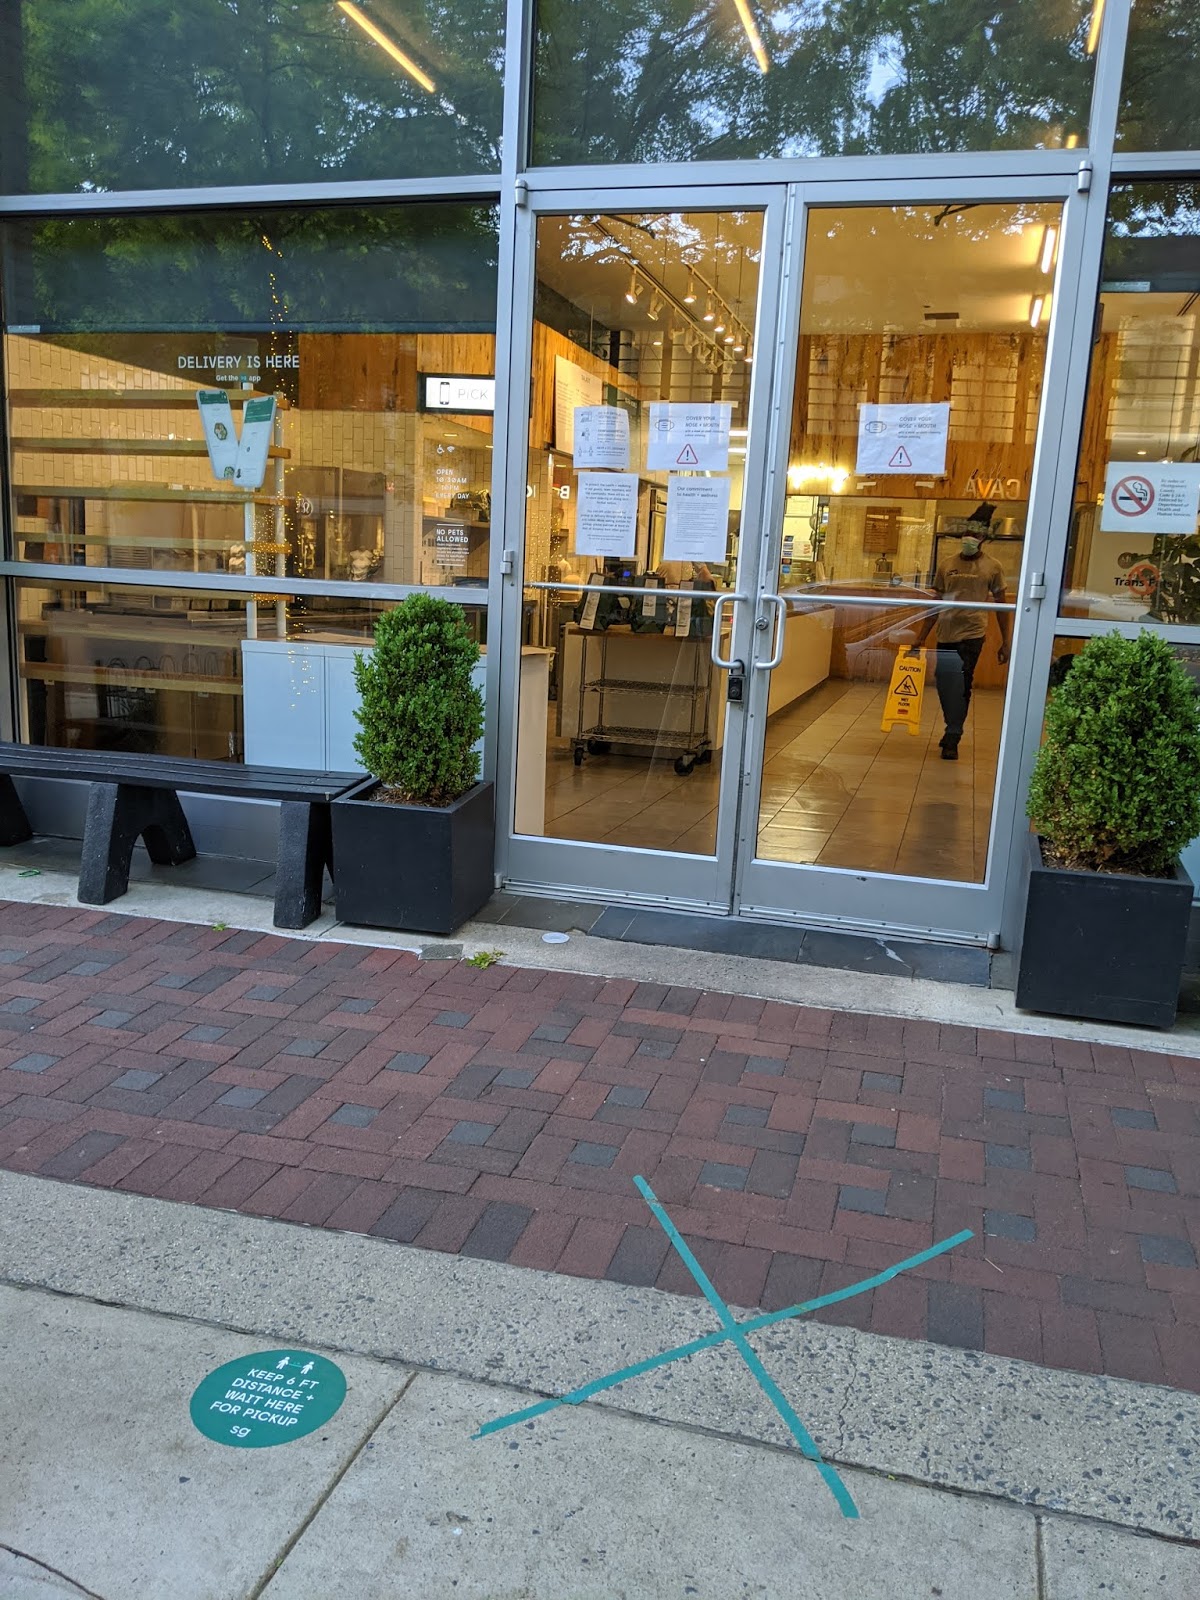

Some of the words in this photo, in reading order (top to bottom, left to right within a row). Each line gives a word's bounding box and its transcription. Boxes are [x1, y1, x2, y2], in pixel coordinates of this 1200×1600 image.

[178, 356, 242, 369] DELIVERY
[247, 356, 261, 368] IS
[266, 355, 300, 369] HERE
[458, 389, 488, 400] PICK
[1114, 577, 1144, 587] Trans
[1149, 578, 1173, 587] Fs
[247, 1368, 284, 1382] KEEP
[286, 1377, 295, 1385] 6
[299, 1380, 319, 1390] FT
[231, 1378, 303, 1400] DISTANCE
[224, 1390, 263, 1405] WAIT
[264, 1399, 304, 1415] HERE
[210, 1401, 241, 1415] FOR
[242, 1407, 298, 1427] PICKUP
[229, 1425, 251, 1438] sg
